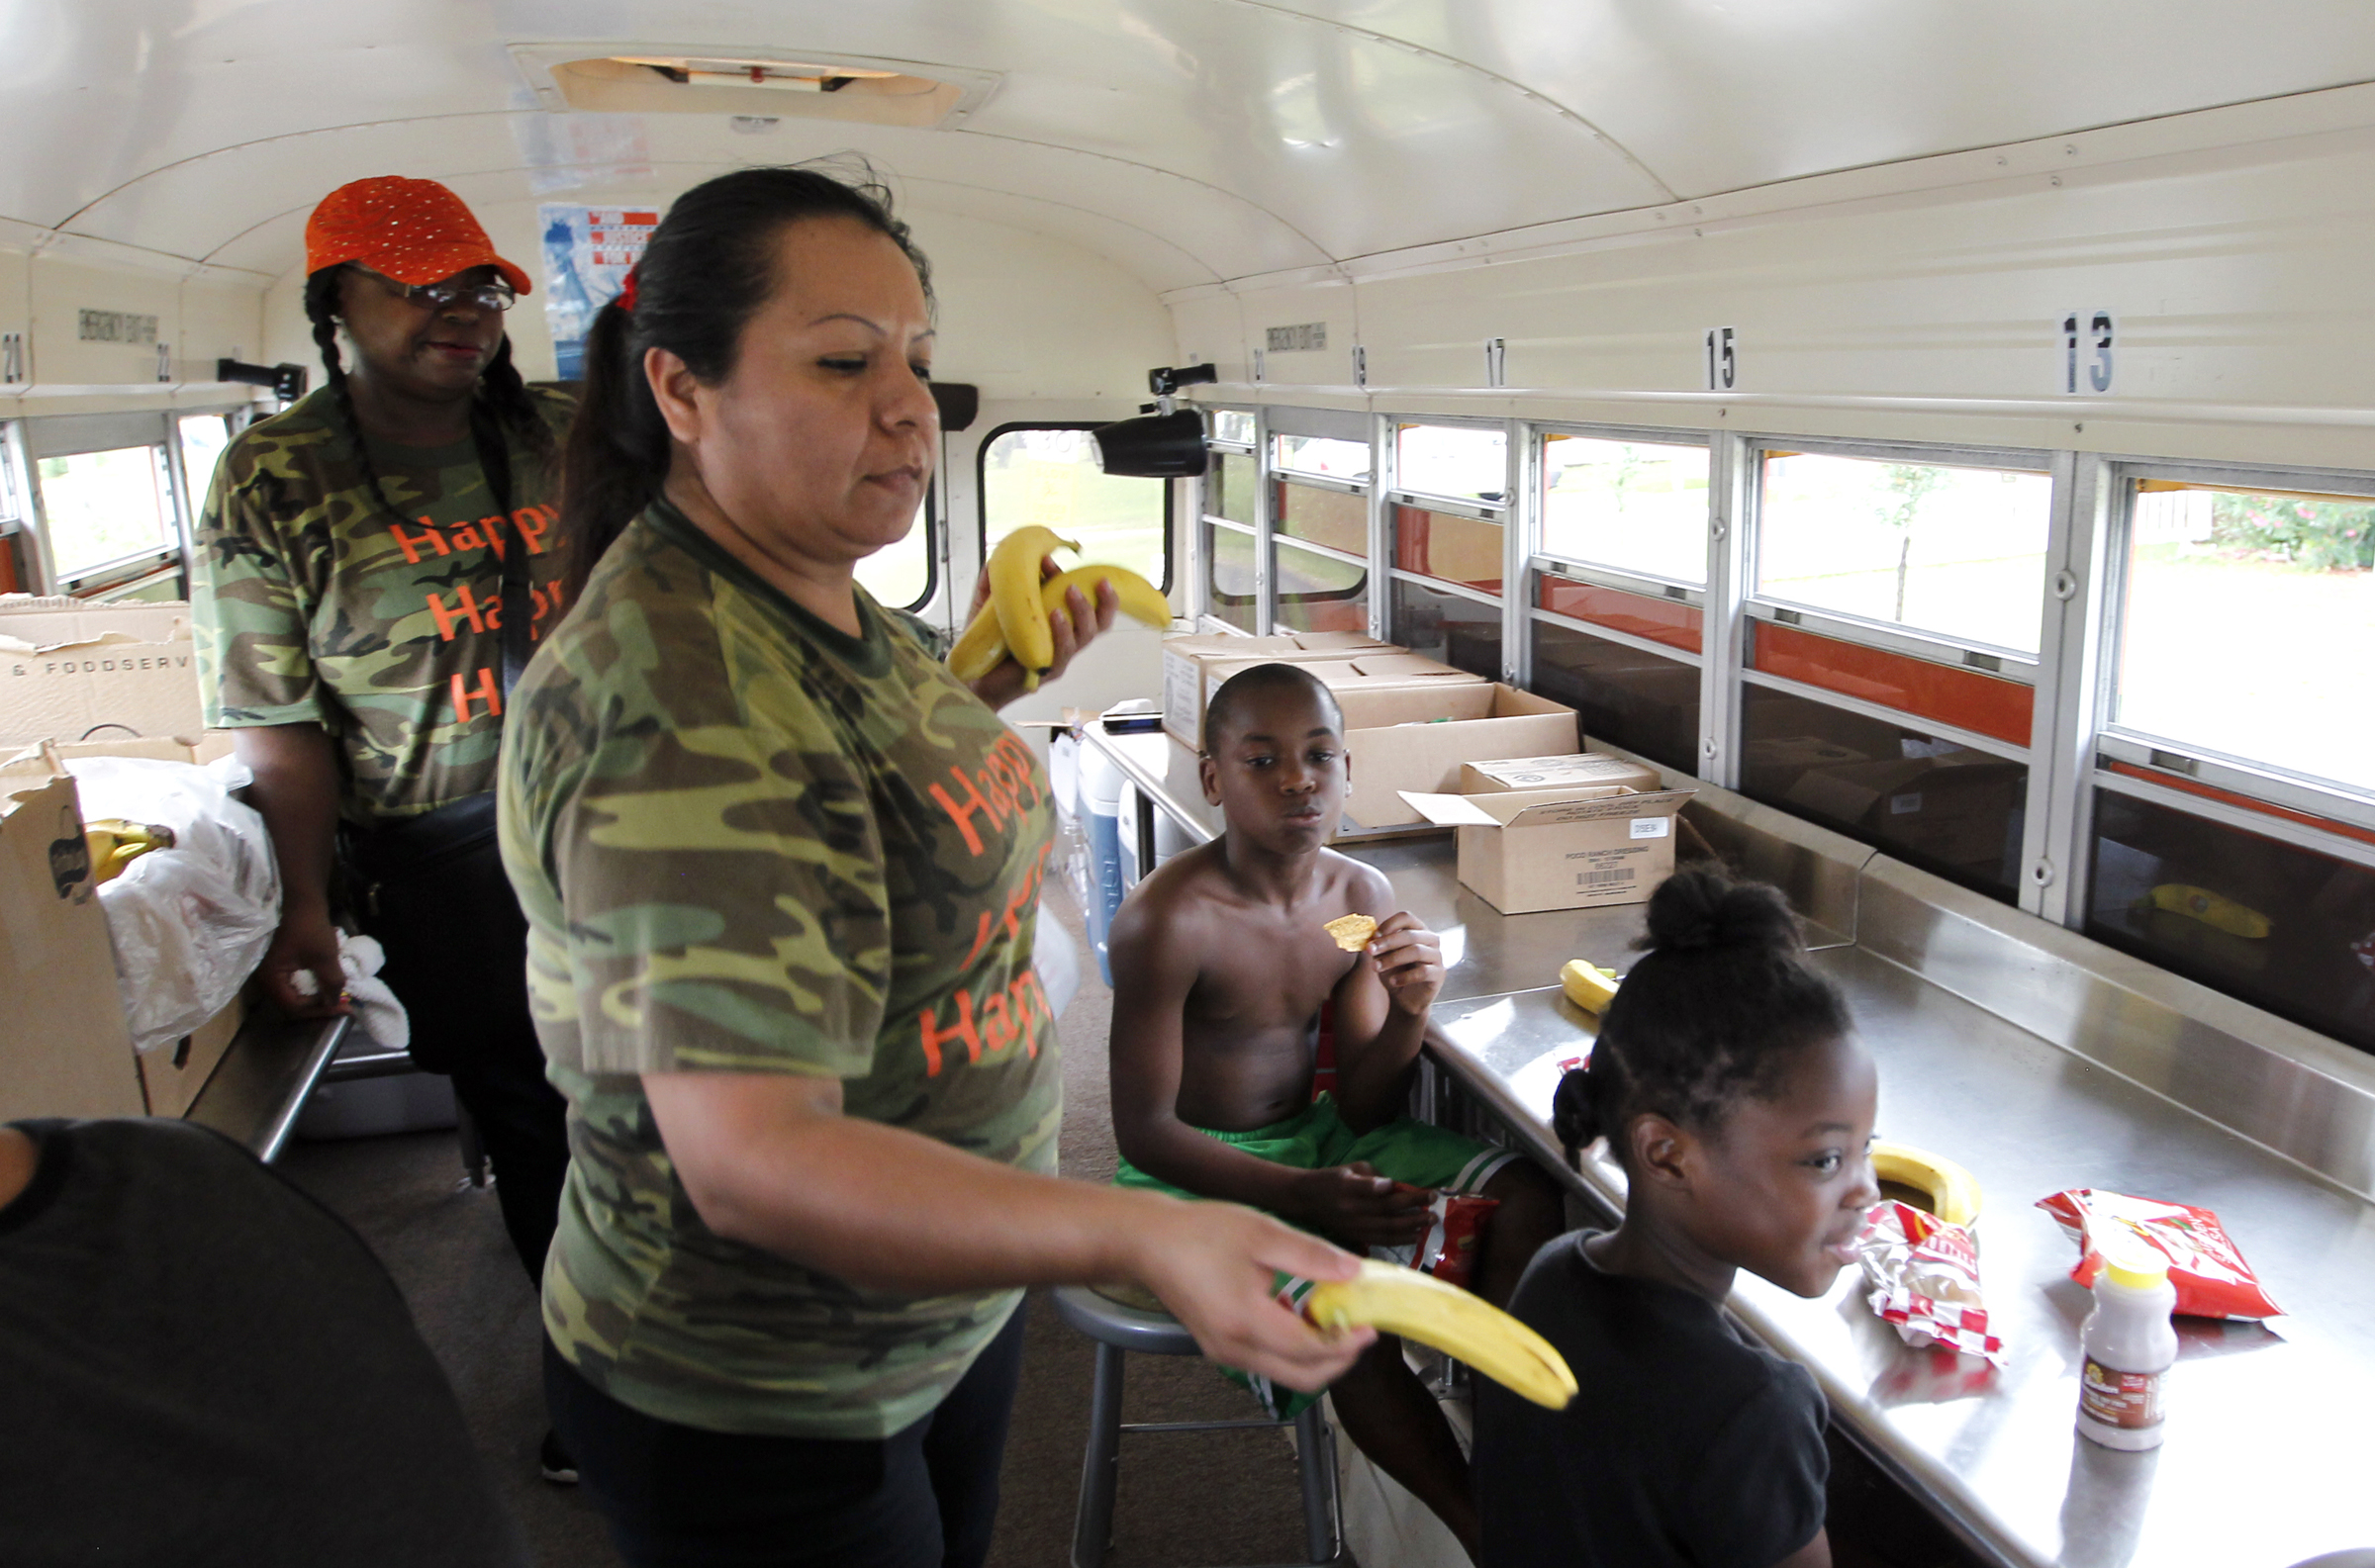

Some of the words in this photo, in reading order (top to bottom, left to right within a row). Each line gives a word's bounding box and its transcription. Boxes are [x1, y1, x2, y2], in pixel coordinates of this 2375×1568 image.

[603, 231, 647, 245] JUSTICE
[1486, 338, 1505, 387] 17
[1707, 327, 1736, 390] 15
[2064, 310, 2112, 393] 13
[12, 664, 27, 676] &
